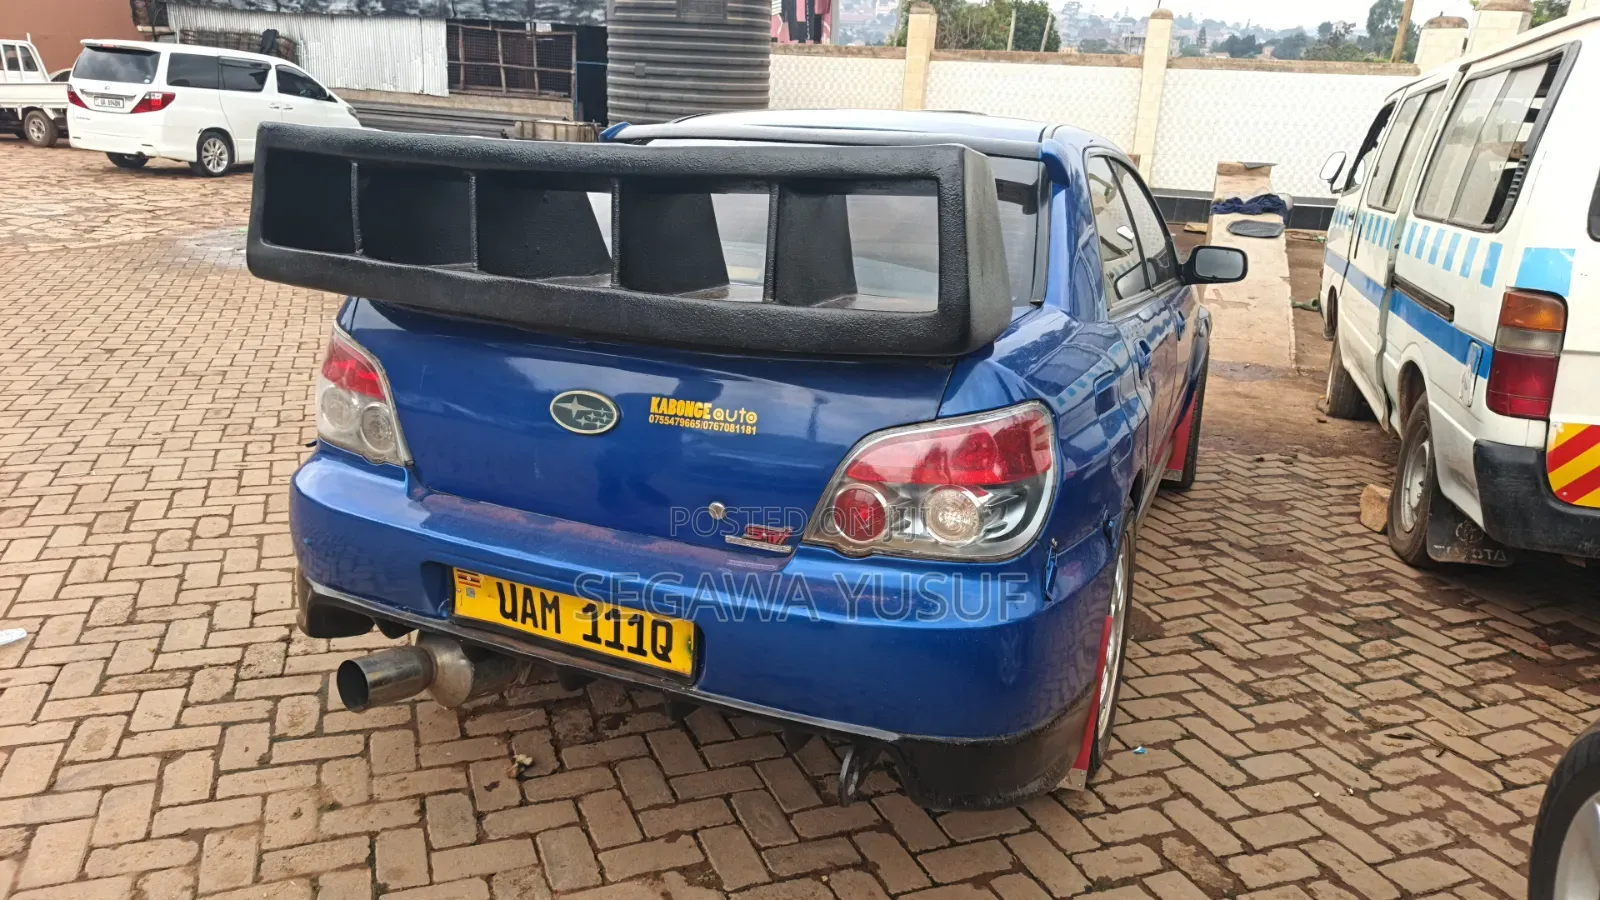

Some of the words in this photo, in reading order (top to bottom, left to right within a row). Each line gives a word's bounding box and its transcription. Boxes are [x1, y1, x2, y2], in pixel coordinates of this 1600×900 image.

[648, 414, 757, 435] 0755479665/0767081181
[712, 407, 758, 424] auto
[495, 581, 562, 635] UAM
[581, 602, 674, 664] 111Q
